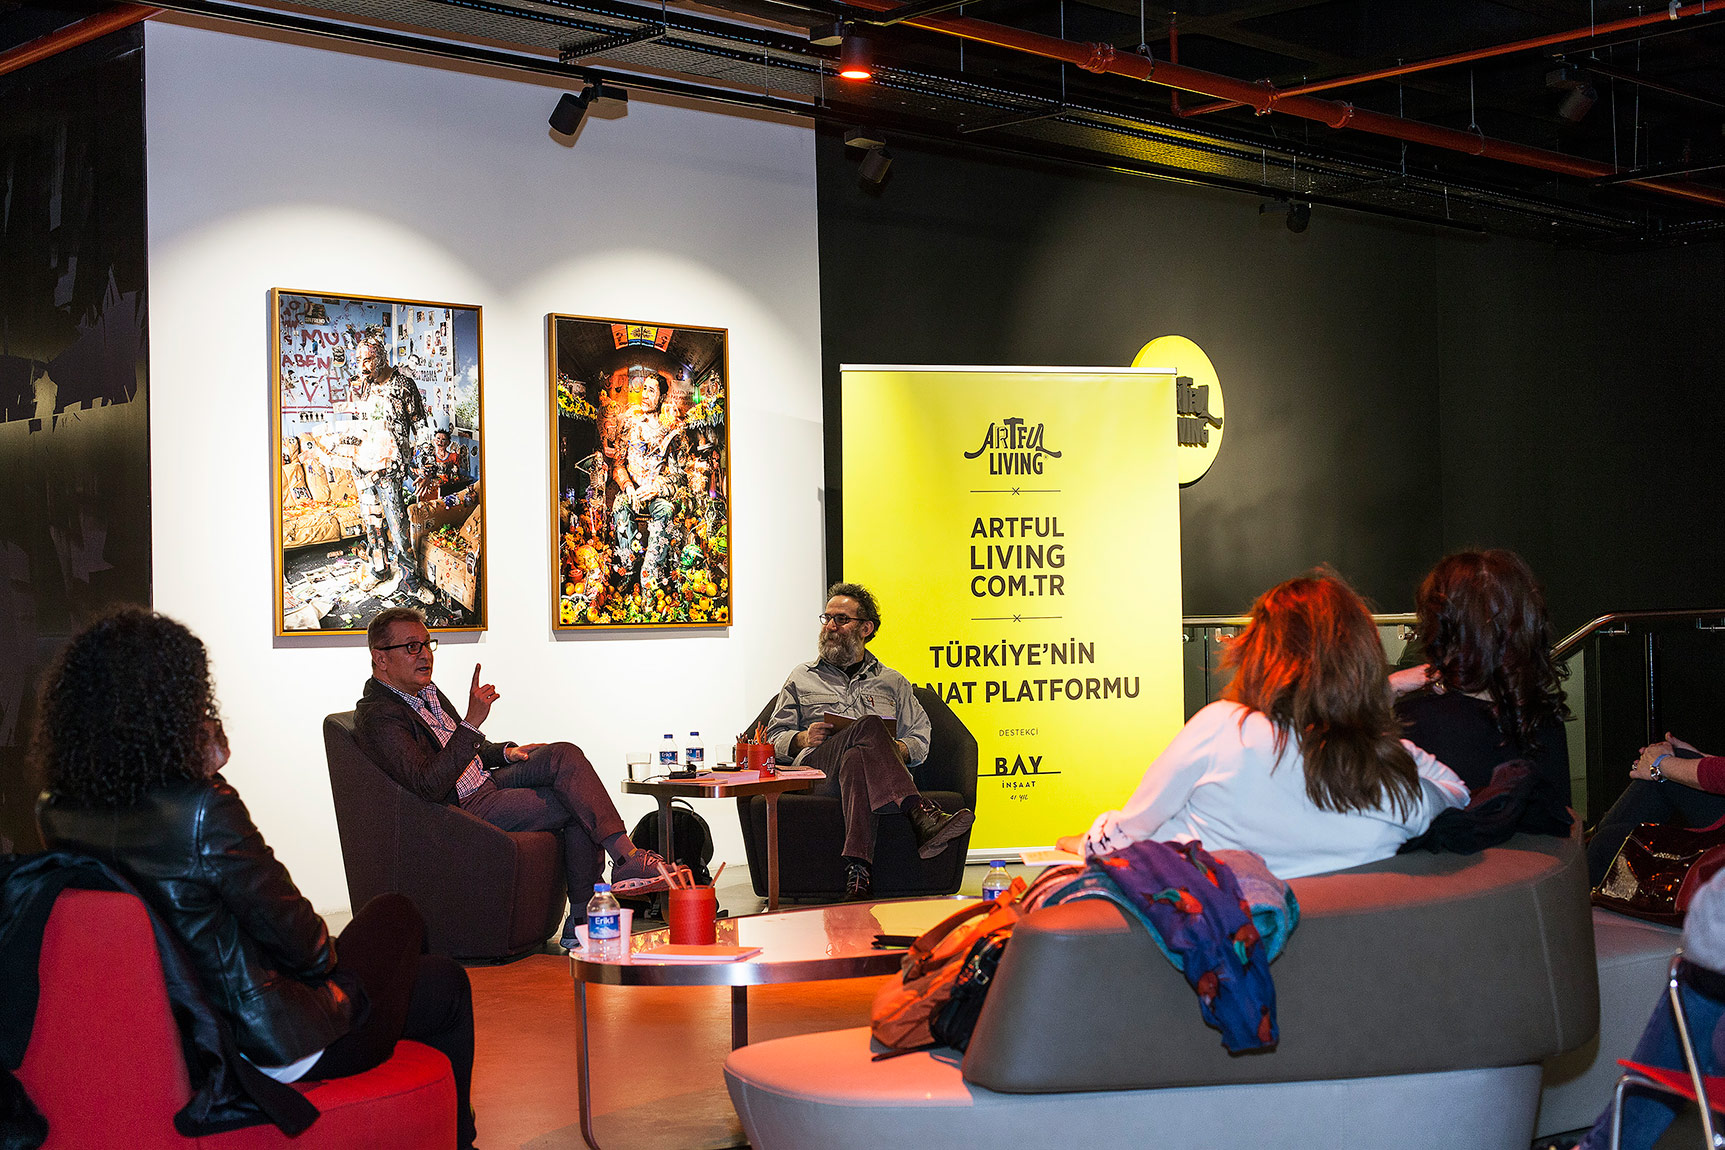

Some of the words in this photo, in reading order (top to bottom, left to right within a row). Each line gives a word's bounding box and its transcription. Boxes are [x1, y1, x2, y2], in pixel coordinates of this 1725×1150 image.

[963, 417, 1062, 459] ARTFUL
[989, 453, 1044, 475] LIVING
[970, 517, 1065, 538] ARTFUL
[970, 544, 1065, 570] LIVING
[970, 574, 1065, 597] COM.TR
[985, 676, 1140, 703] PLATFORMU
[995, 754, 1043, 776] BAY
